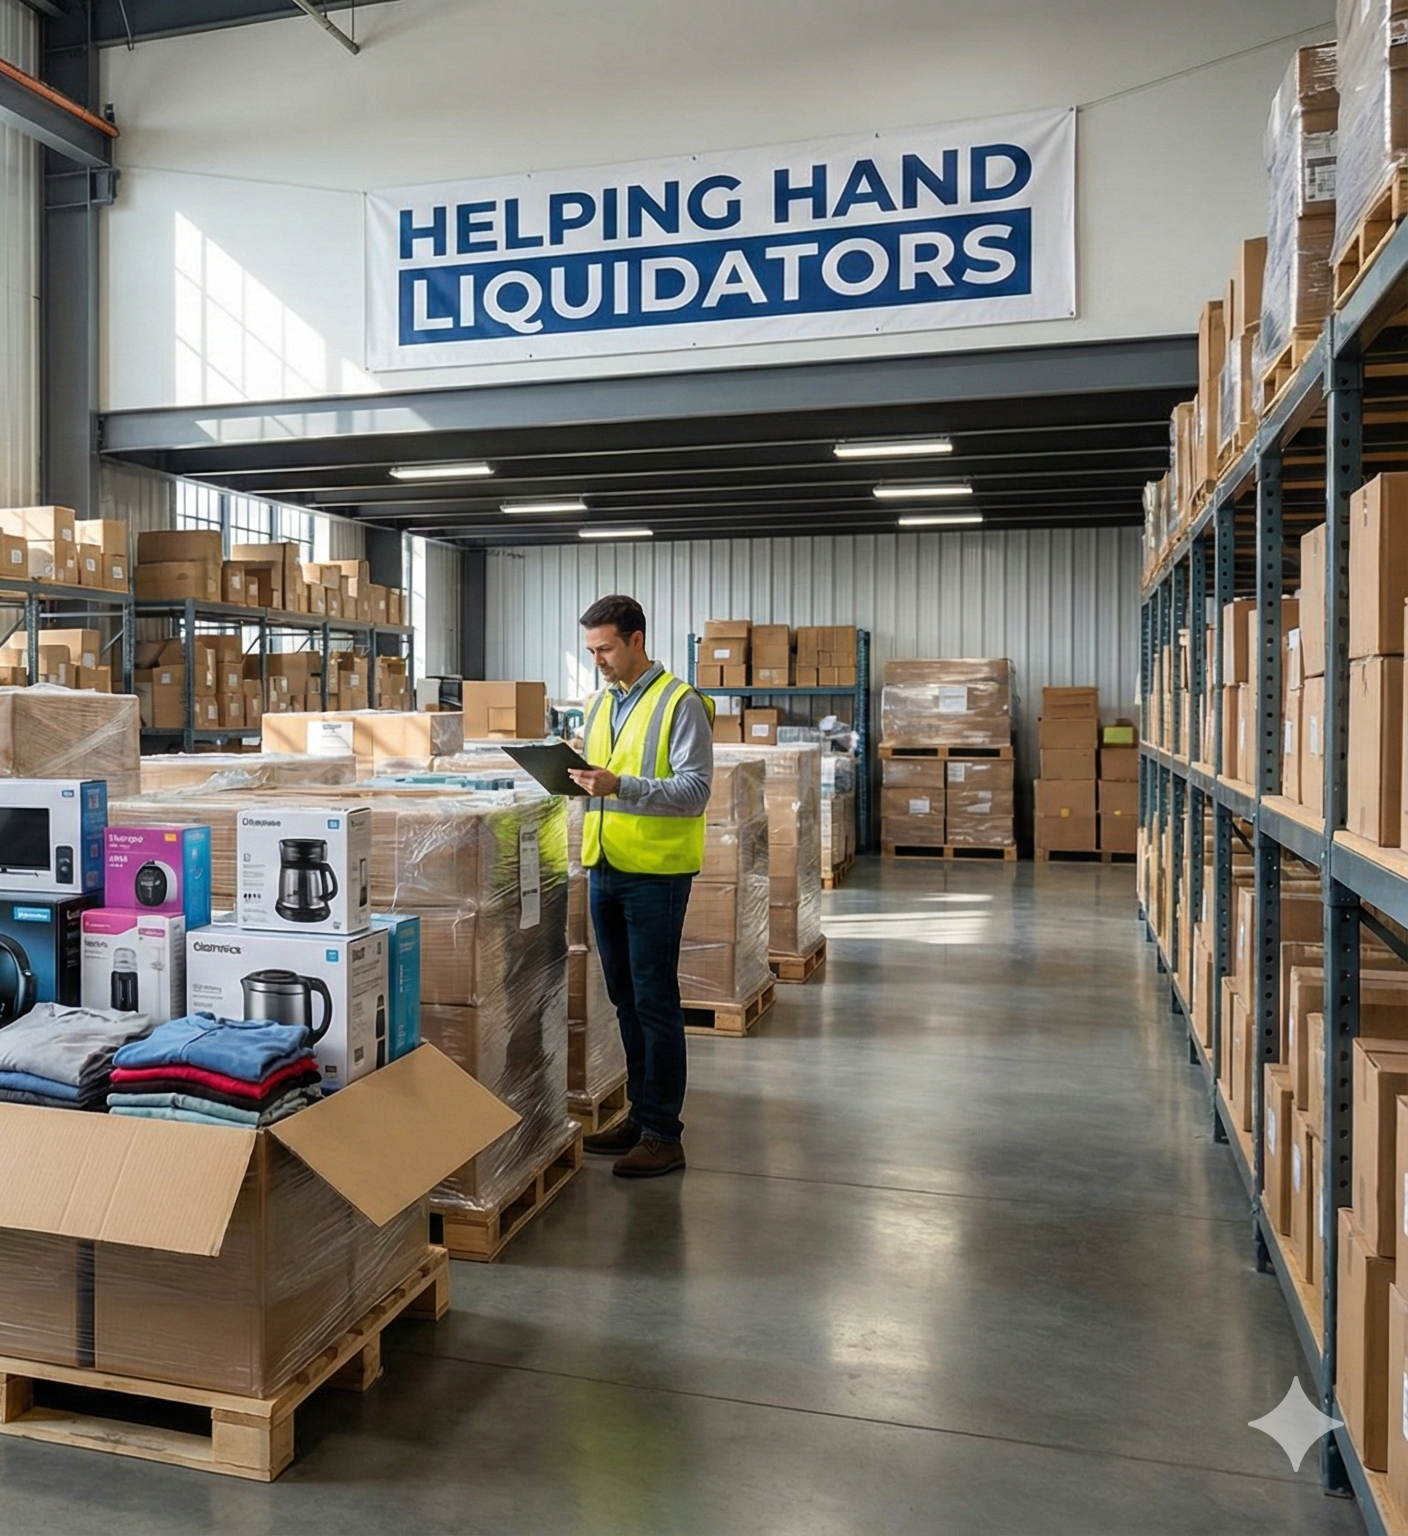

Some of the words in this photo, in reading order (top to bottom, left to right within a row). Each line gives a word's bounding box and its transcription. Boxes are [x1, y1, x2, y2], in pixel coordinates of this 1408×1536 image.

[398, 175, 742, 261] HELPING
[773, 143, 1032, 223] HAND
[412, 223, 1019, 335] LIQUIDATORS
